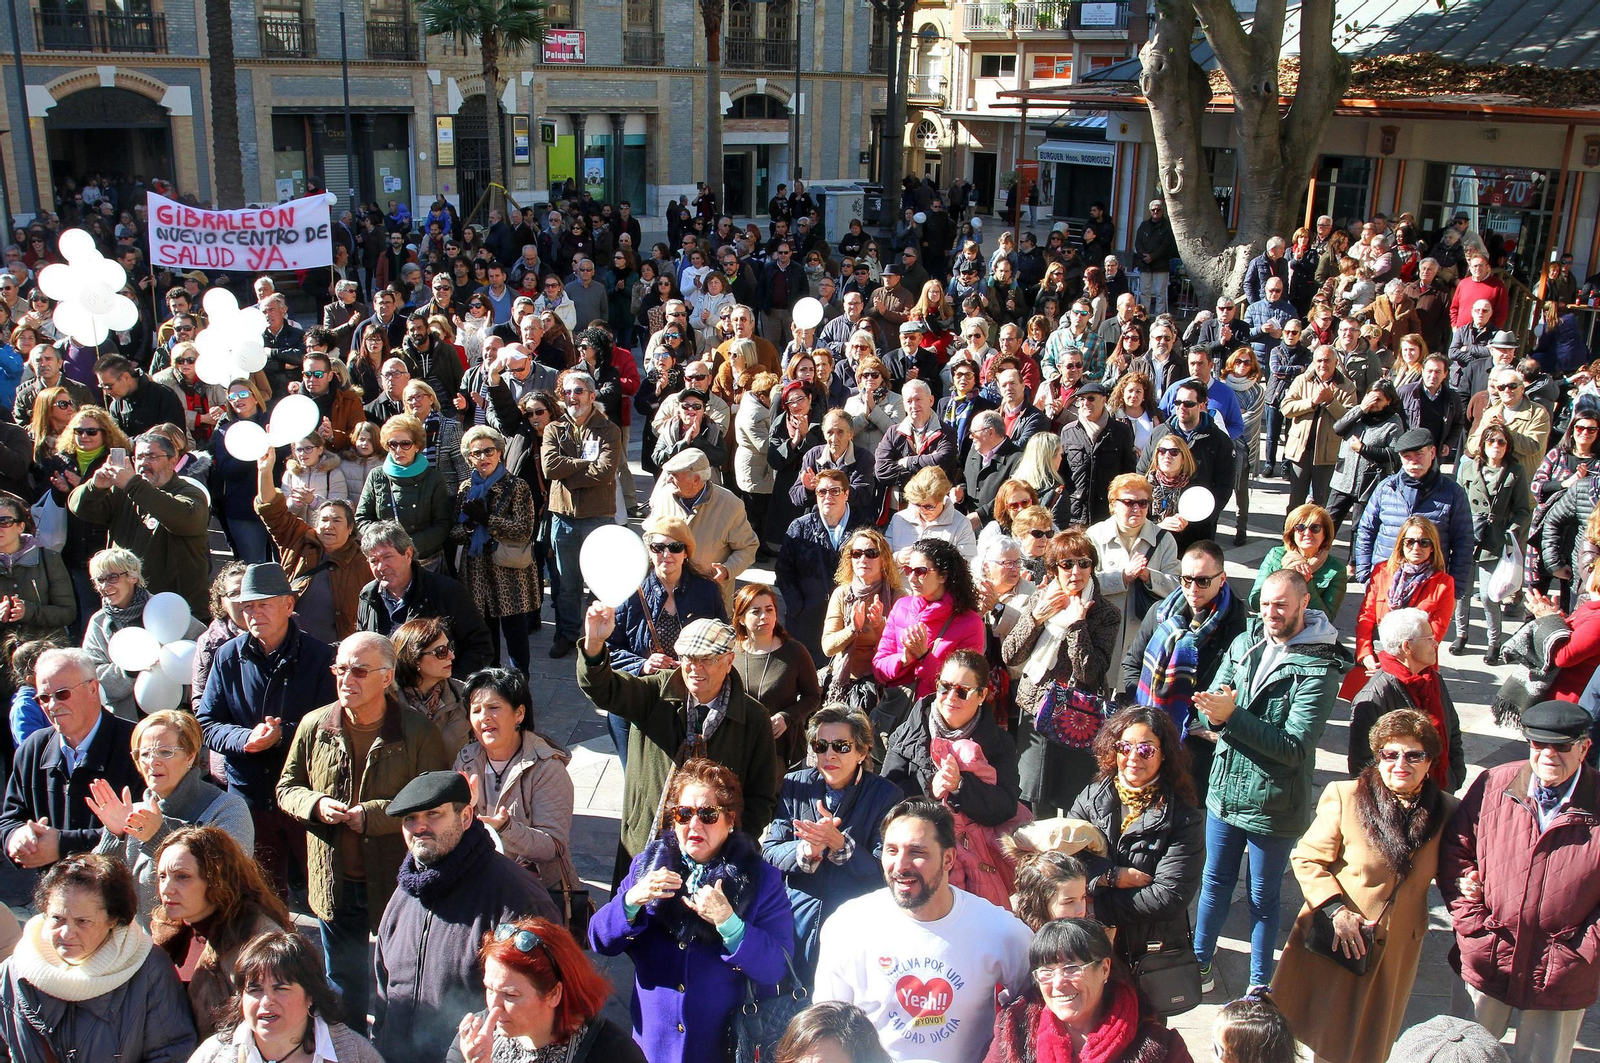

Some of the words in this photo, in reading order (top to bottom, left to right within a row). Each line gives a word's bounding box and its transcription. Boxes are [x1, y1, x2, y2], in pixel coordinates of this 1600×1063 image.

[1040, 151, 1063, 161] BURGUER
[156, 227, 218, 244] NUEVO
[221, 227, 299, 246] CENTRO
[305, 224, 328, 243] DE
[159, 244, 235, 268] SALUD
[924, 957, 945, 974] POR
[900, 988, 948, 1011] Yeah!!
[914, 1015, 944, 1028] #YOVOY
